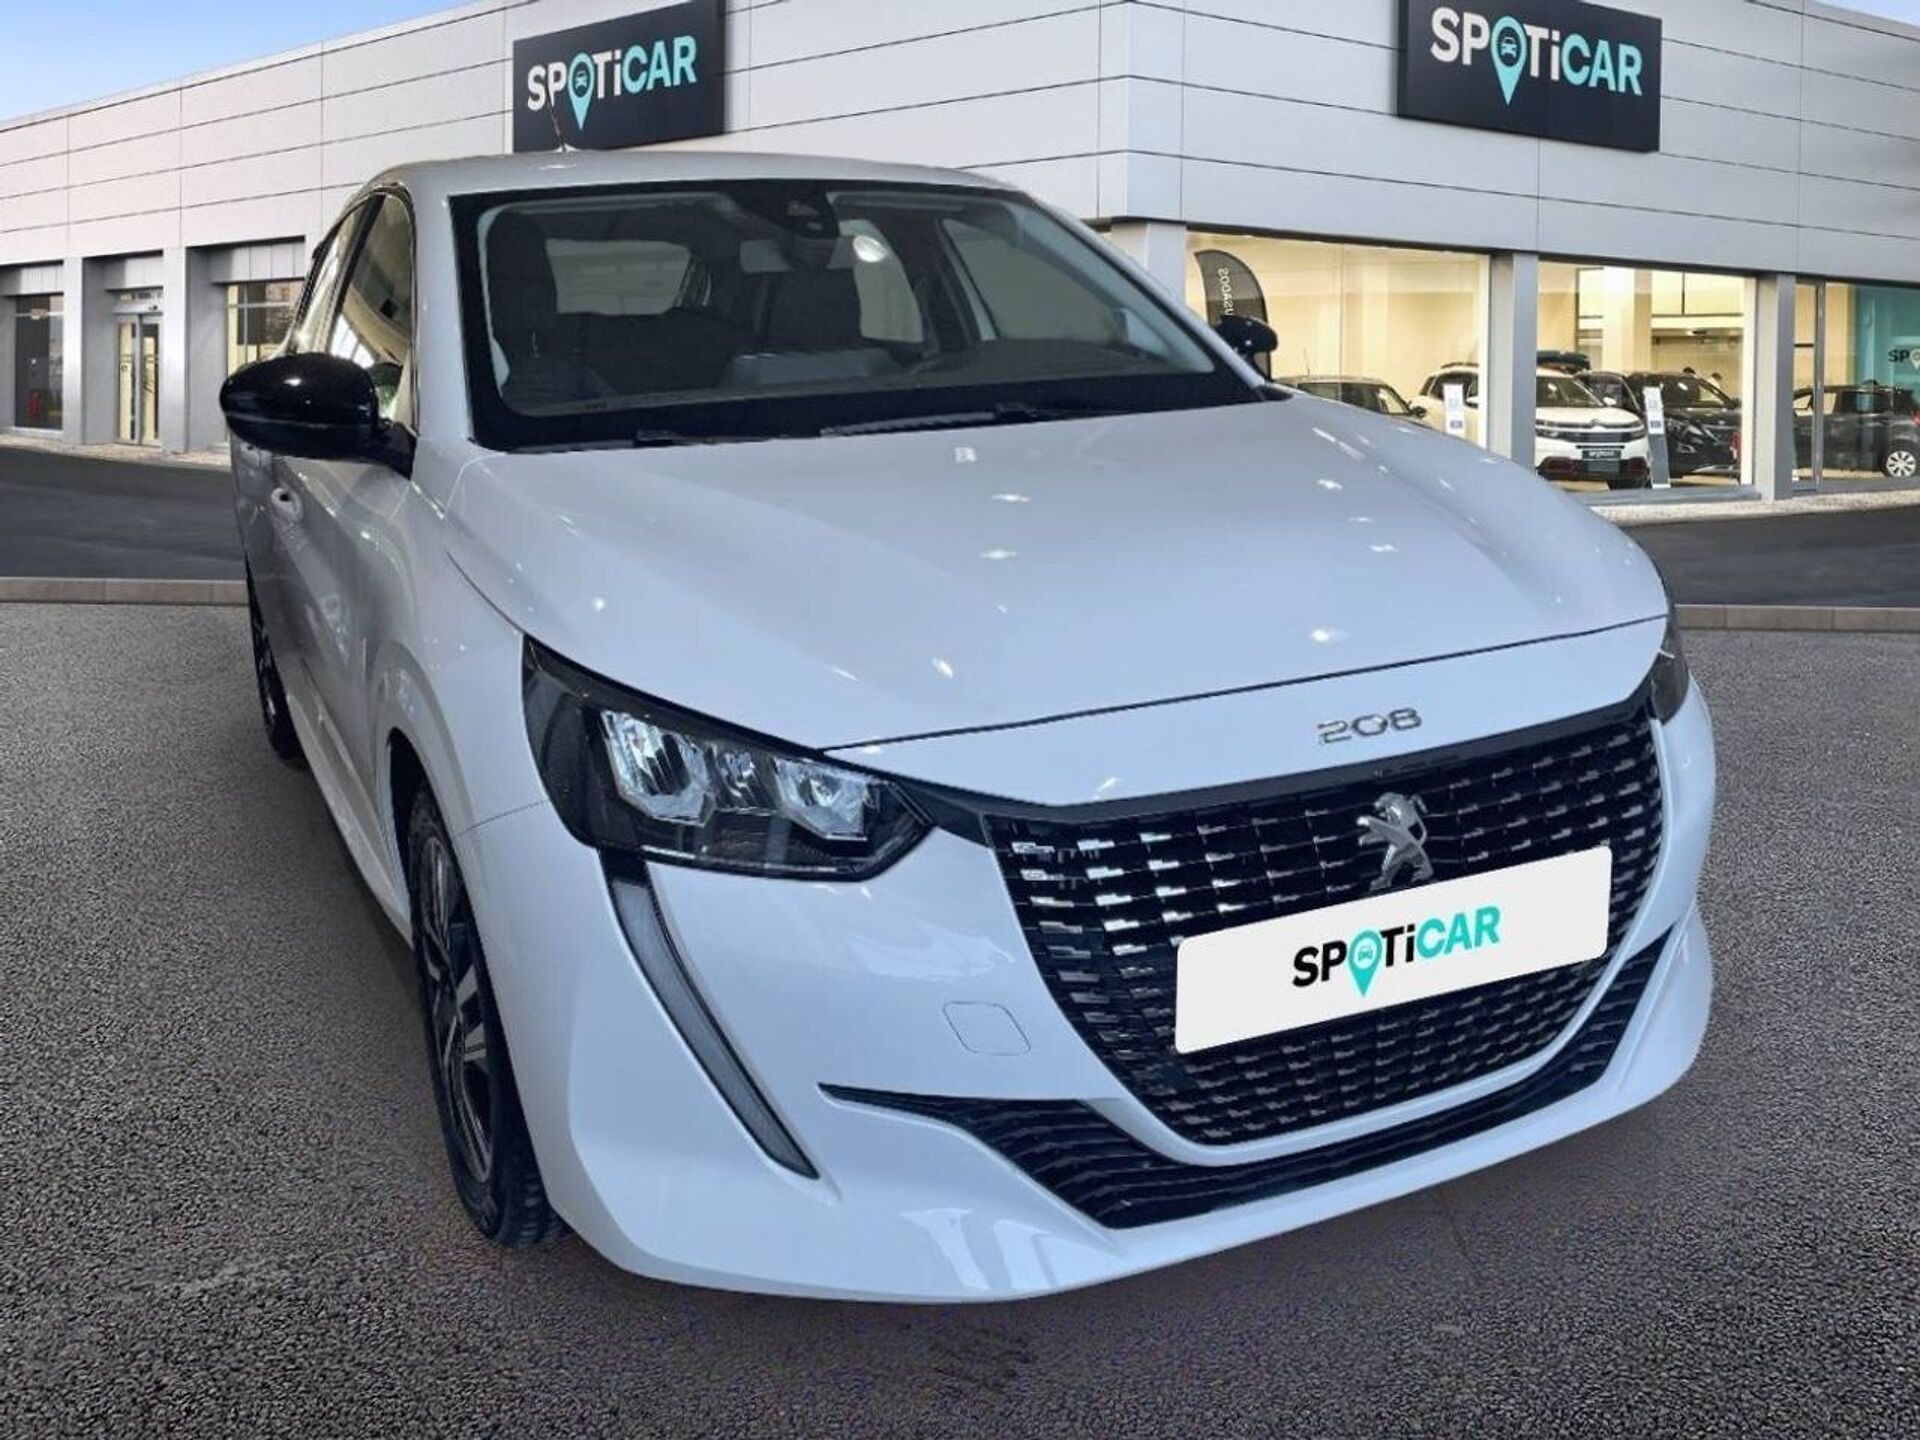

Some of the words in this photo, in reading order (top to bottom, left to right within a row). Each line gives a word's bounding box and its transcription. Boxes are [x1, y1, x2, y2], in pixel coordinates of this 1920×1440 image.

[527, 35, 697, 130] SPOTiCAR
[1431, 7, 1643, 105] SPOTiCAR
[1317, 707, 1422, 744] 208
[1292, 906, 1500, 997] SPOTiCAR
